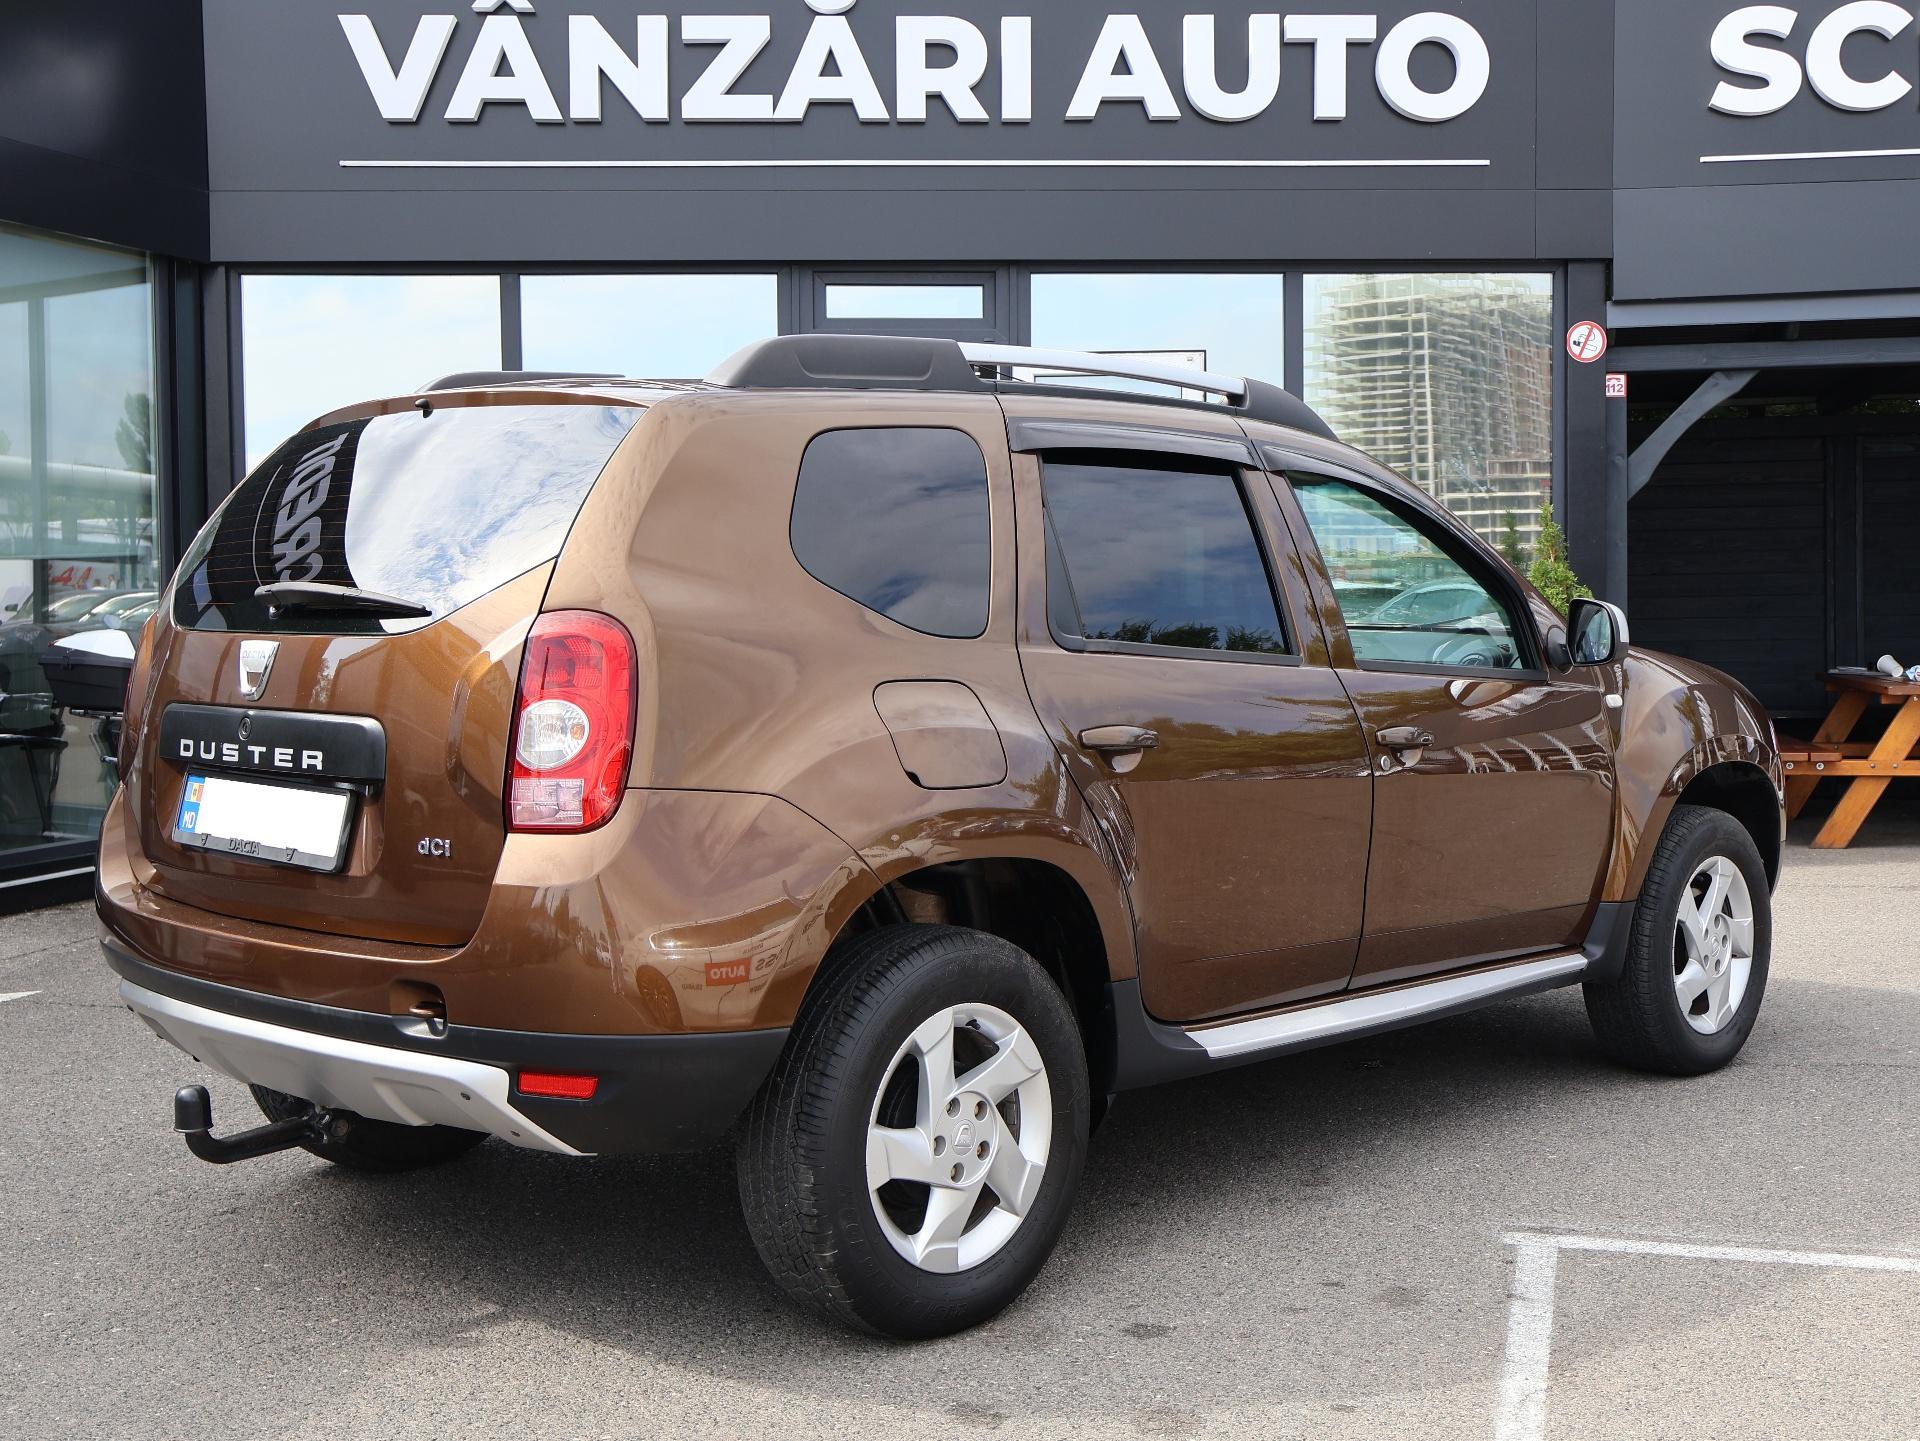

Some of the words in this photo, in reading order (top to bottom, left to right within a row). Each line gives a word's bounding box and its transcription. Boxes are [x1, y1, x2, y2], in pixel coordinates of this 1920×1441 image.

[337, 0, 1032, 123] VÂNZĂRI
[1064, 11, 1491, 123] AUTO
[1606, 383, 1624, 394] 112
[179, 738, 323, 771] DUSTER
[182, 811, 196, 828] MD
[228, 838, 260, 855] DACIA
